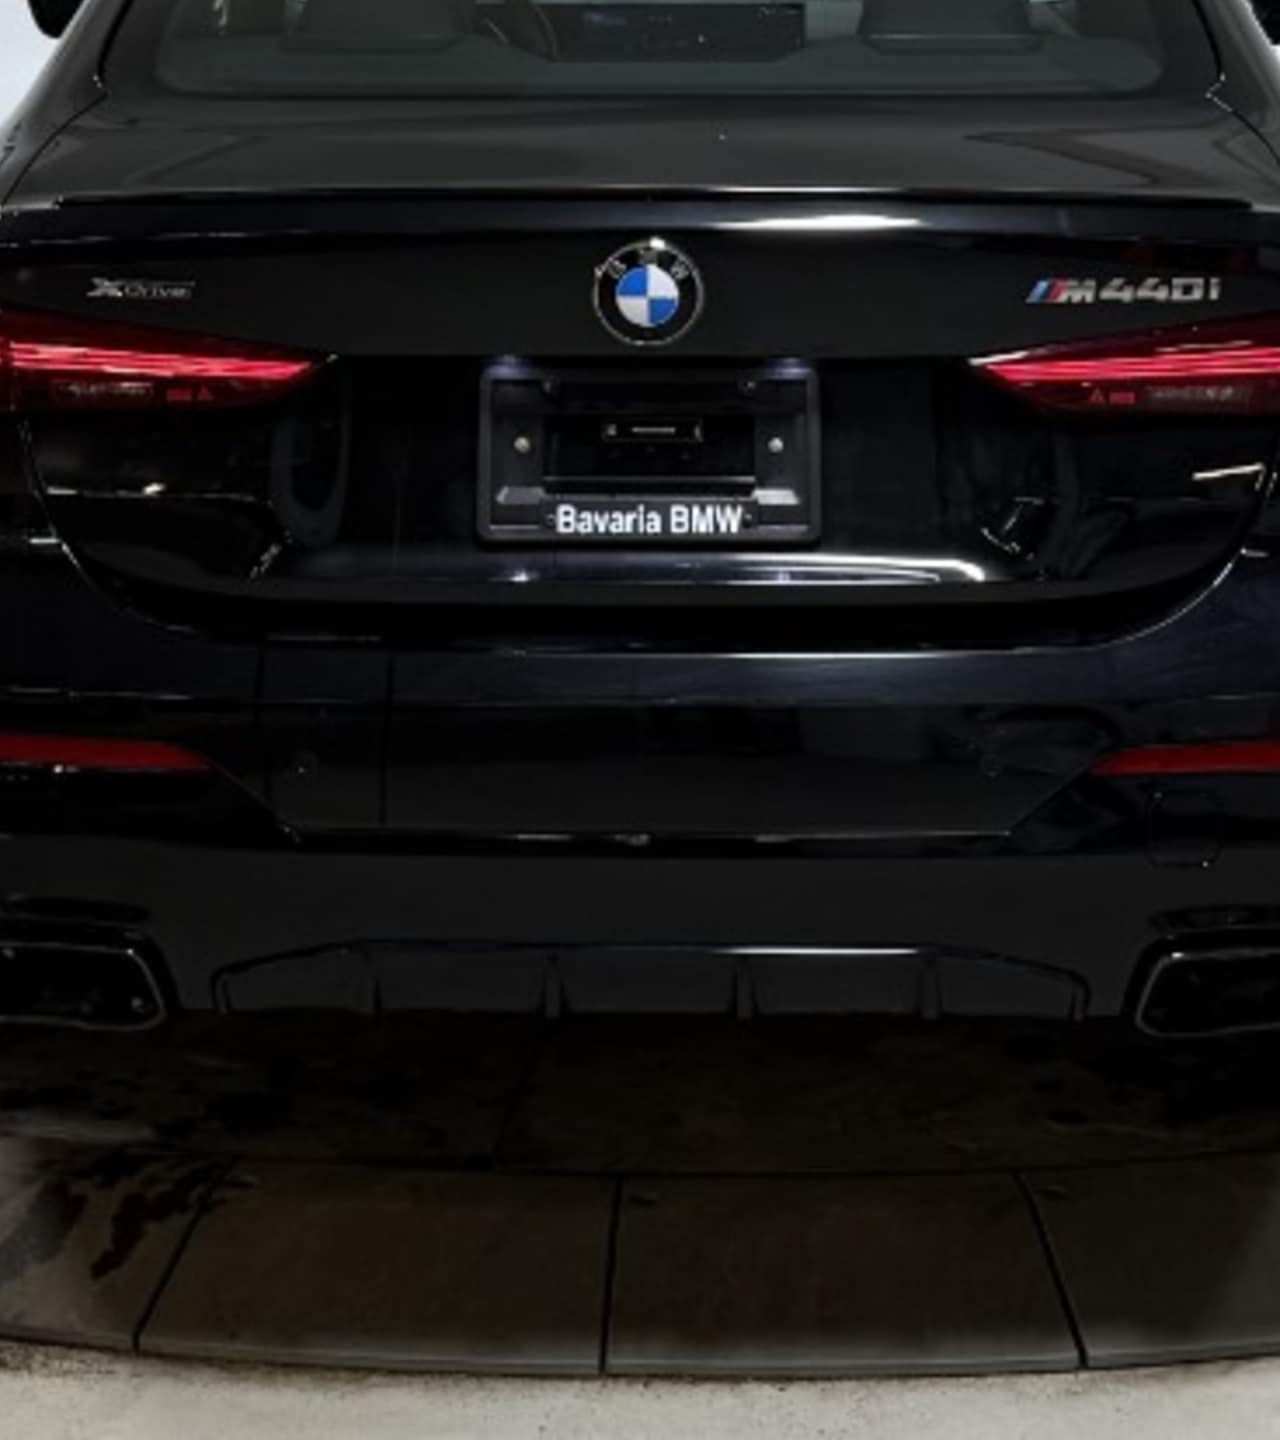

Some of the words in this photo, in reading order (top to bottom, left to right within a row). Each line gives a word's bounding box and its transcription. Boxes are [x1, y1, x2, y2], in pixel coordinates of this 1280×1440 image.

[1026, 277, 1220, 303] M440i
[556, 504, 662, 534] Bavaria
[670, 504, 742, 534] BMW
